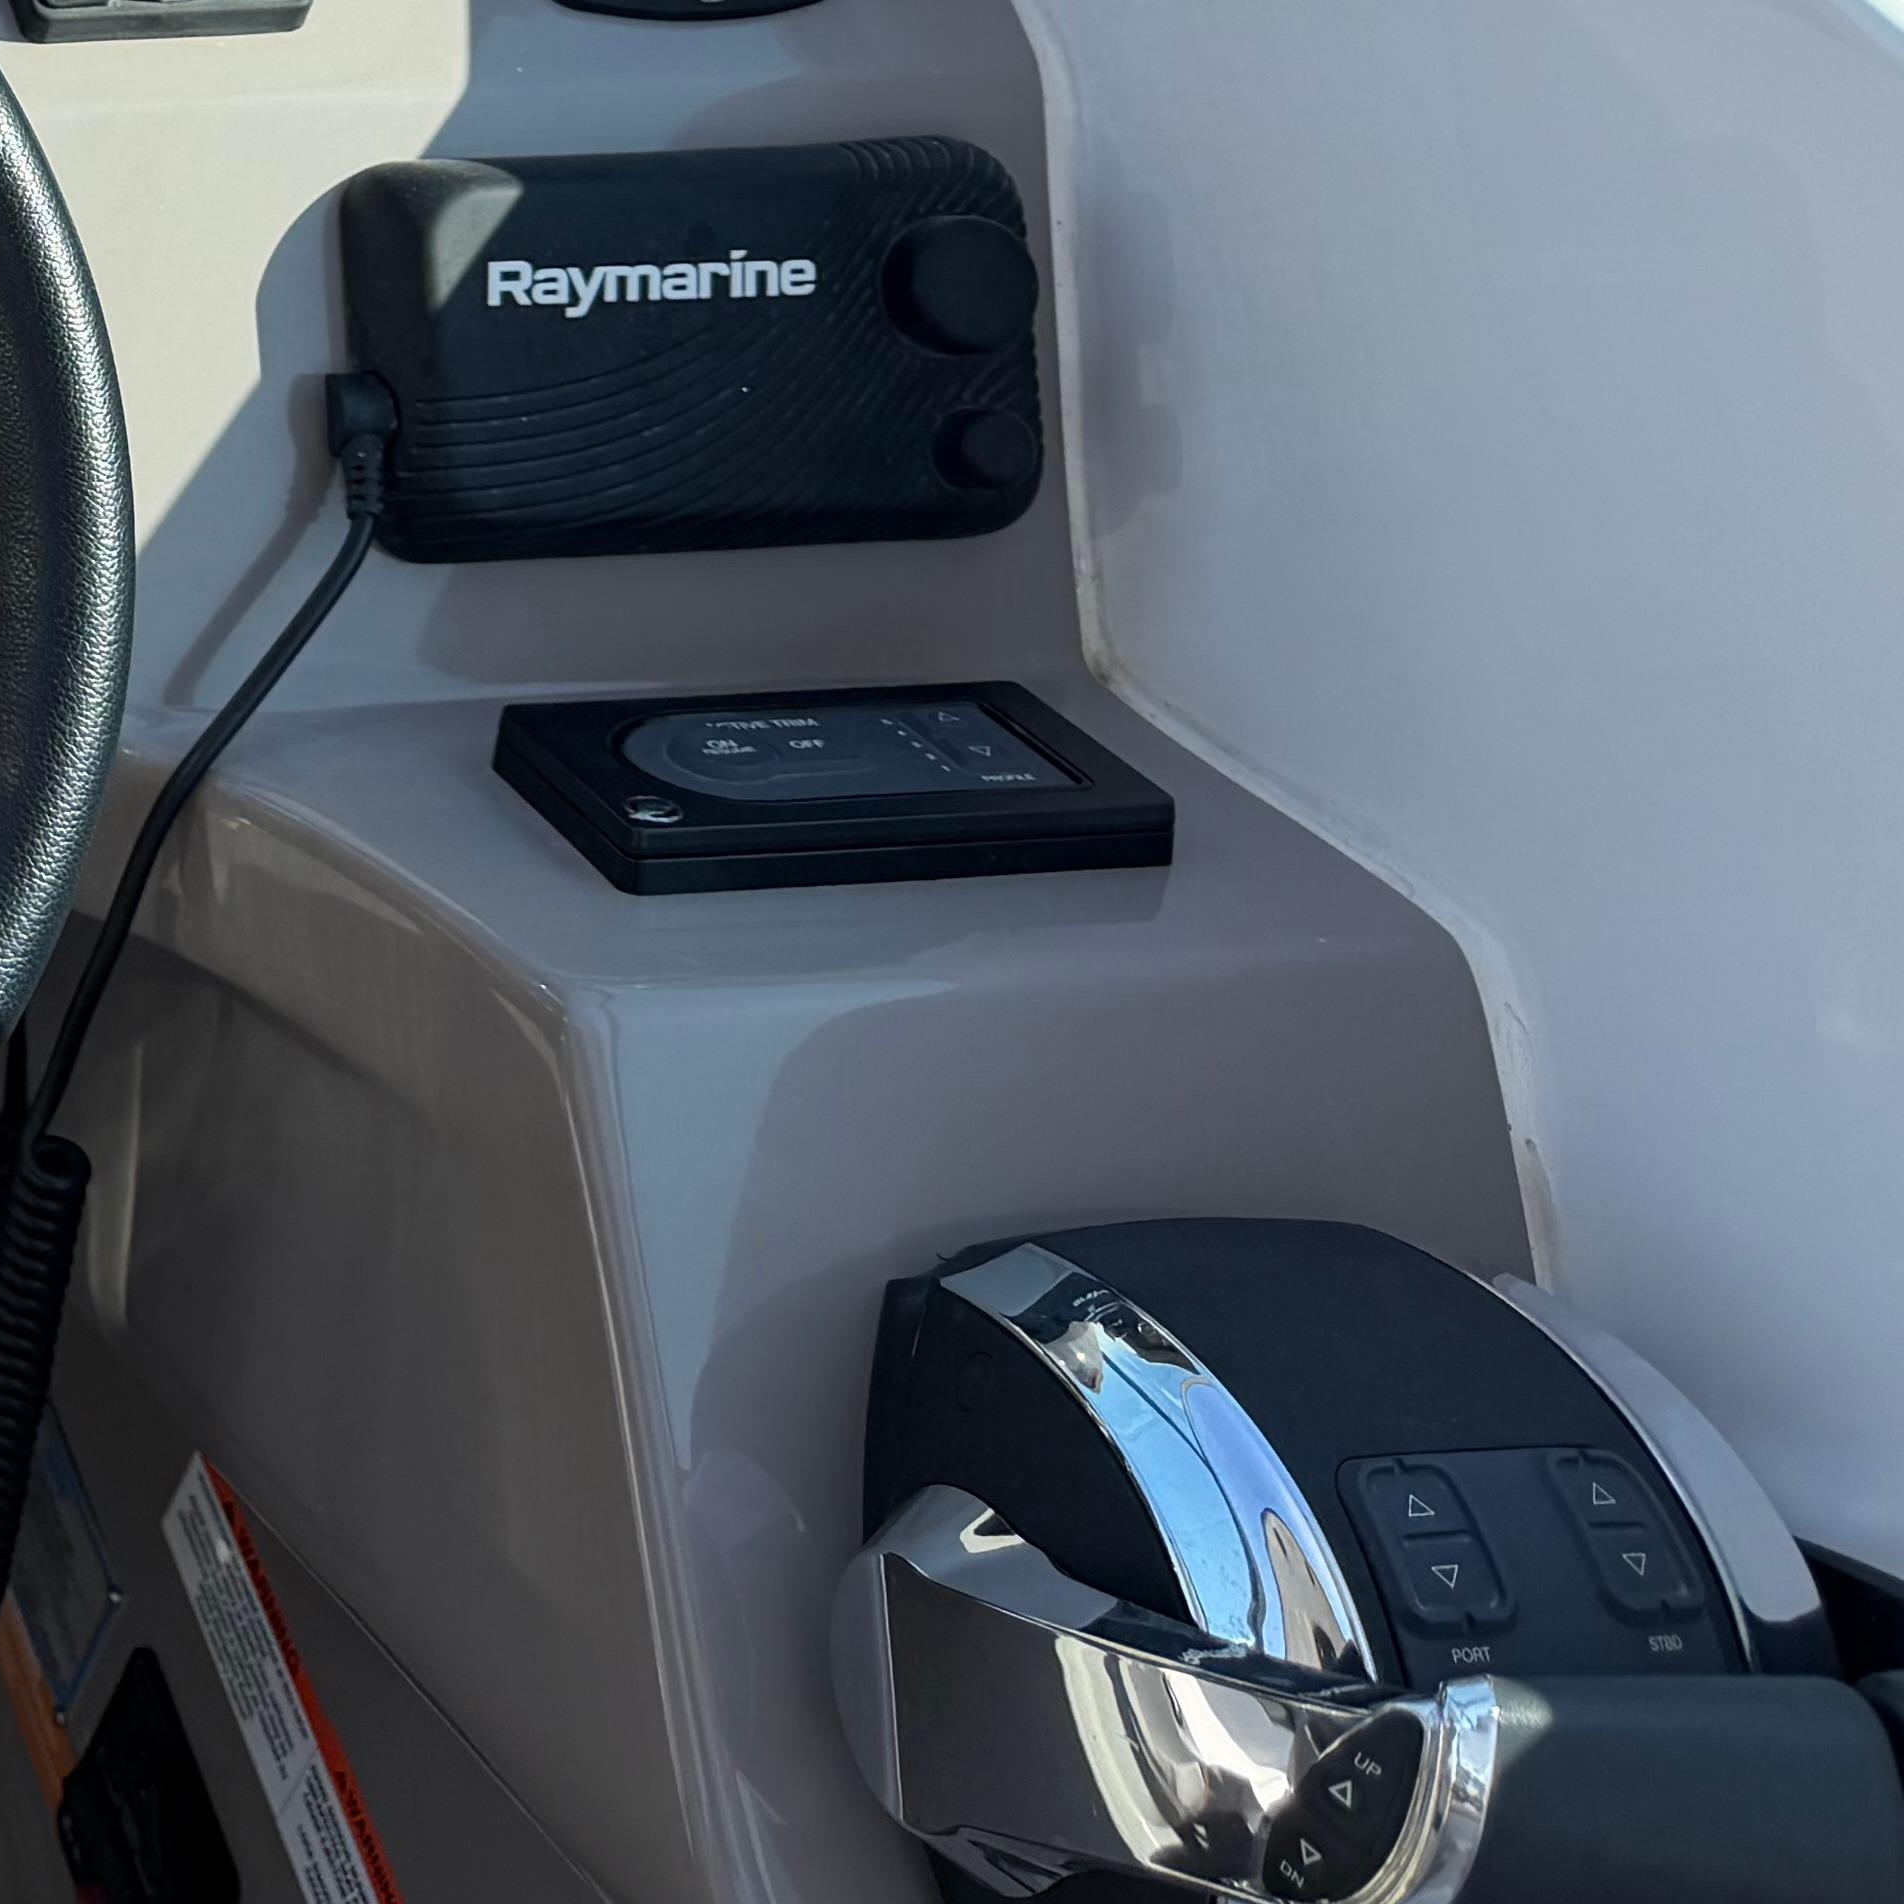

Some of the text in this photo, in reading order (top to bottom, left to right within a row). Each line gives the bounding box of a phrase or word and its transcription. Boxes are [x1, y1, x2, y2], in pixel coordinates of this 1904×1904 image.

[487, 250, 817, 318] Raymarine
[1451, 1646, 1491, 1664] PORT
[1648, 1634, 1684, 1652] STBD
[1353, 1751, 1383, 1777] UP
[1280, 1858, 1305, 1889] DN
